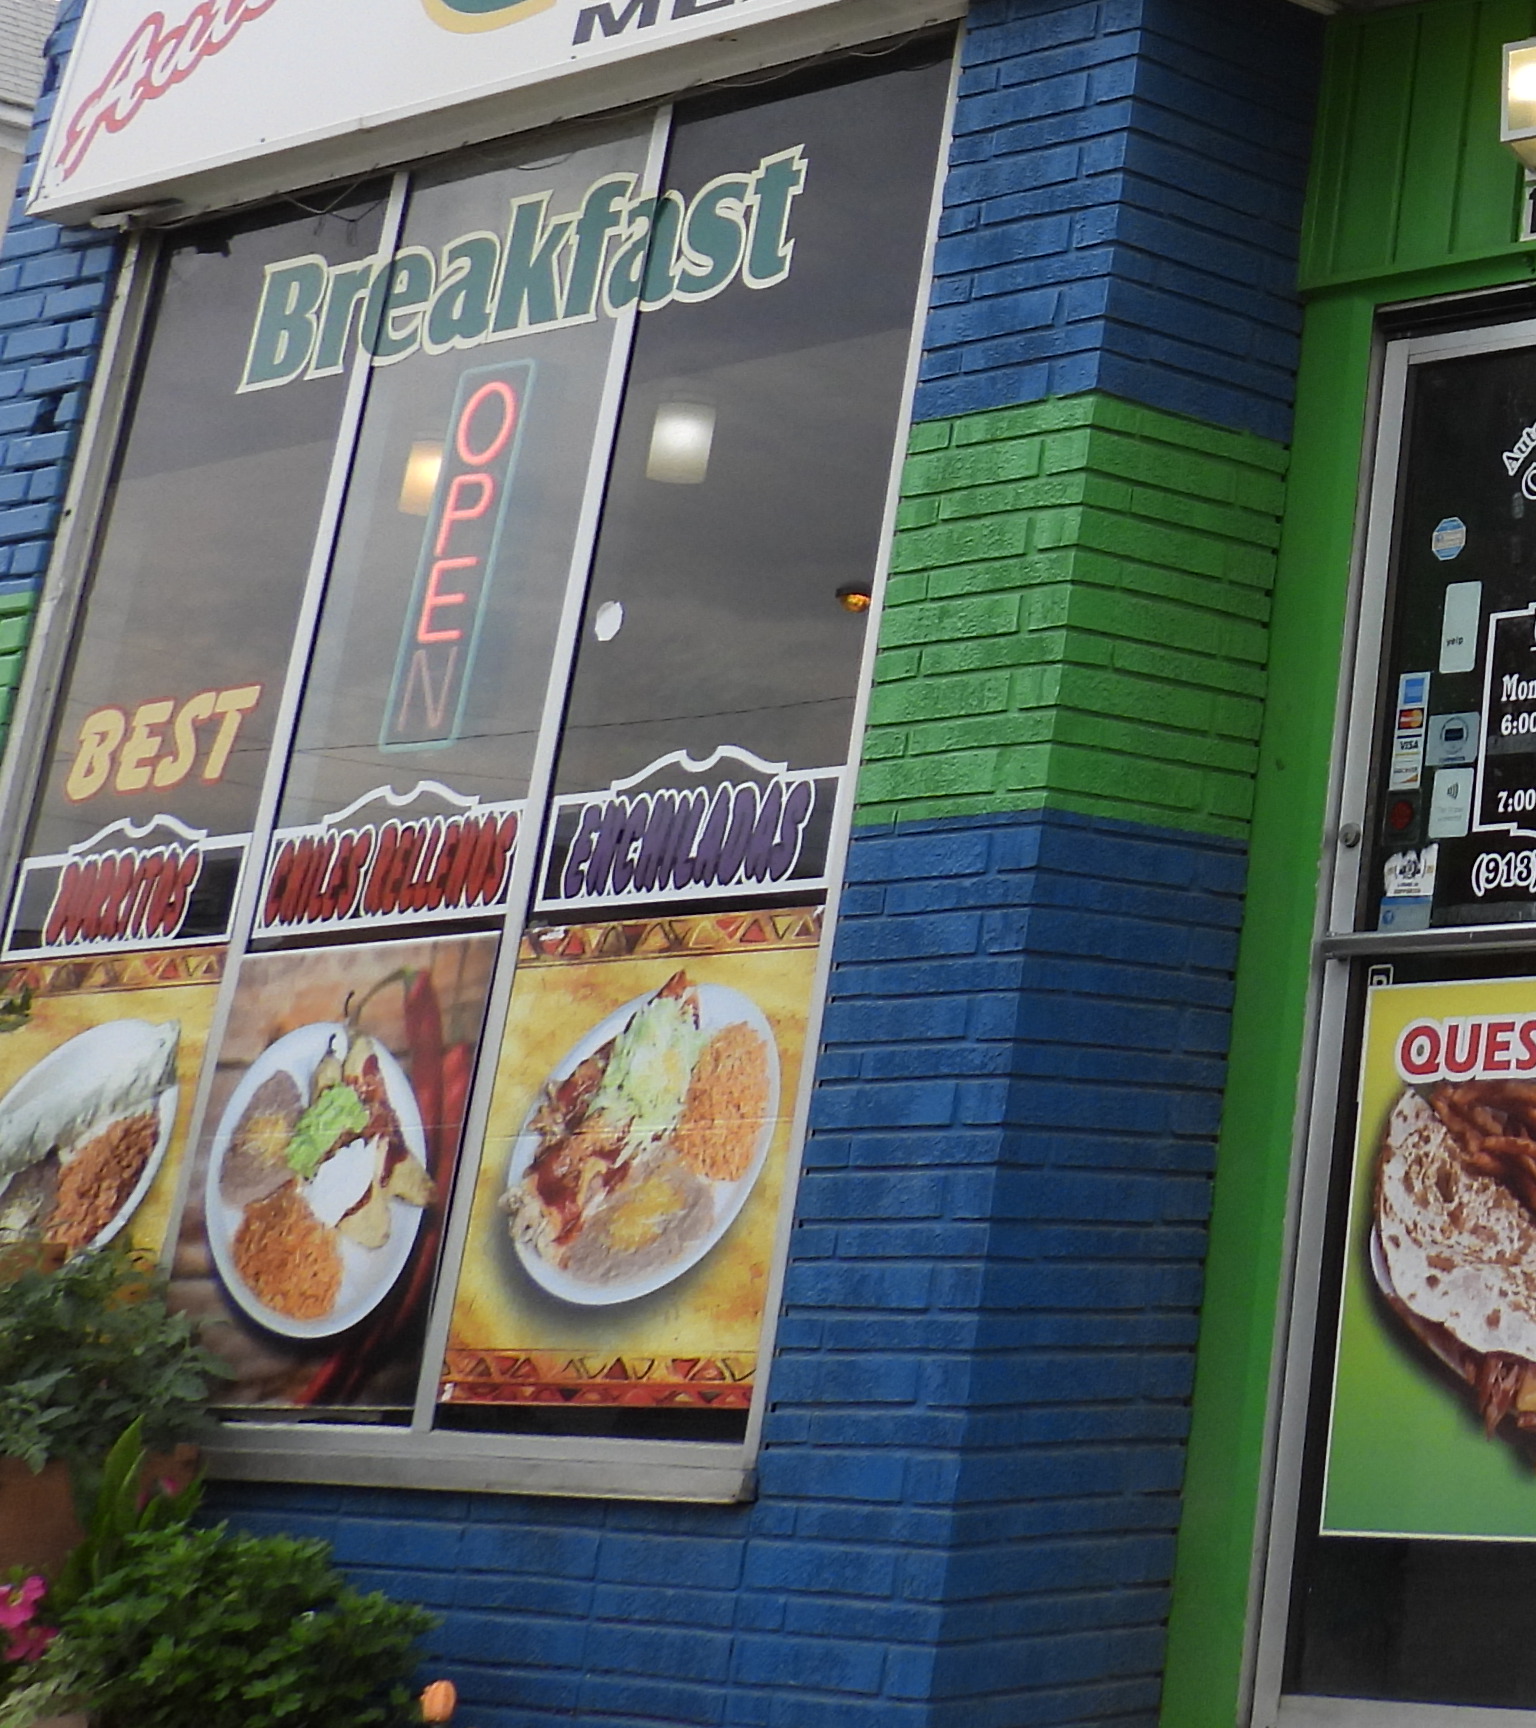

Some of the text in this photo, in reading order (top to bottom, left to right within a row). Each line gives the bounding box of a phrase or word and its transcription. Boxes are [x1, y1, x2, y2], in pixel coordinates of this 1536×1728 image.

[237, 145, 805, 394] Breakfast
[399, 380, 516, 732] OPEN
[66, 683, 262, 802] BEST
[1497, 789, 1536, 812] 7:00
[263, 809, 519, 928] CHILES RELLENOS
[561, 777, 815, 899] ENCHILADAS
